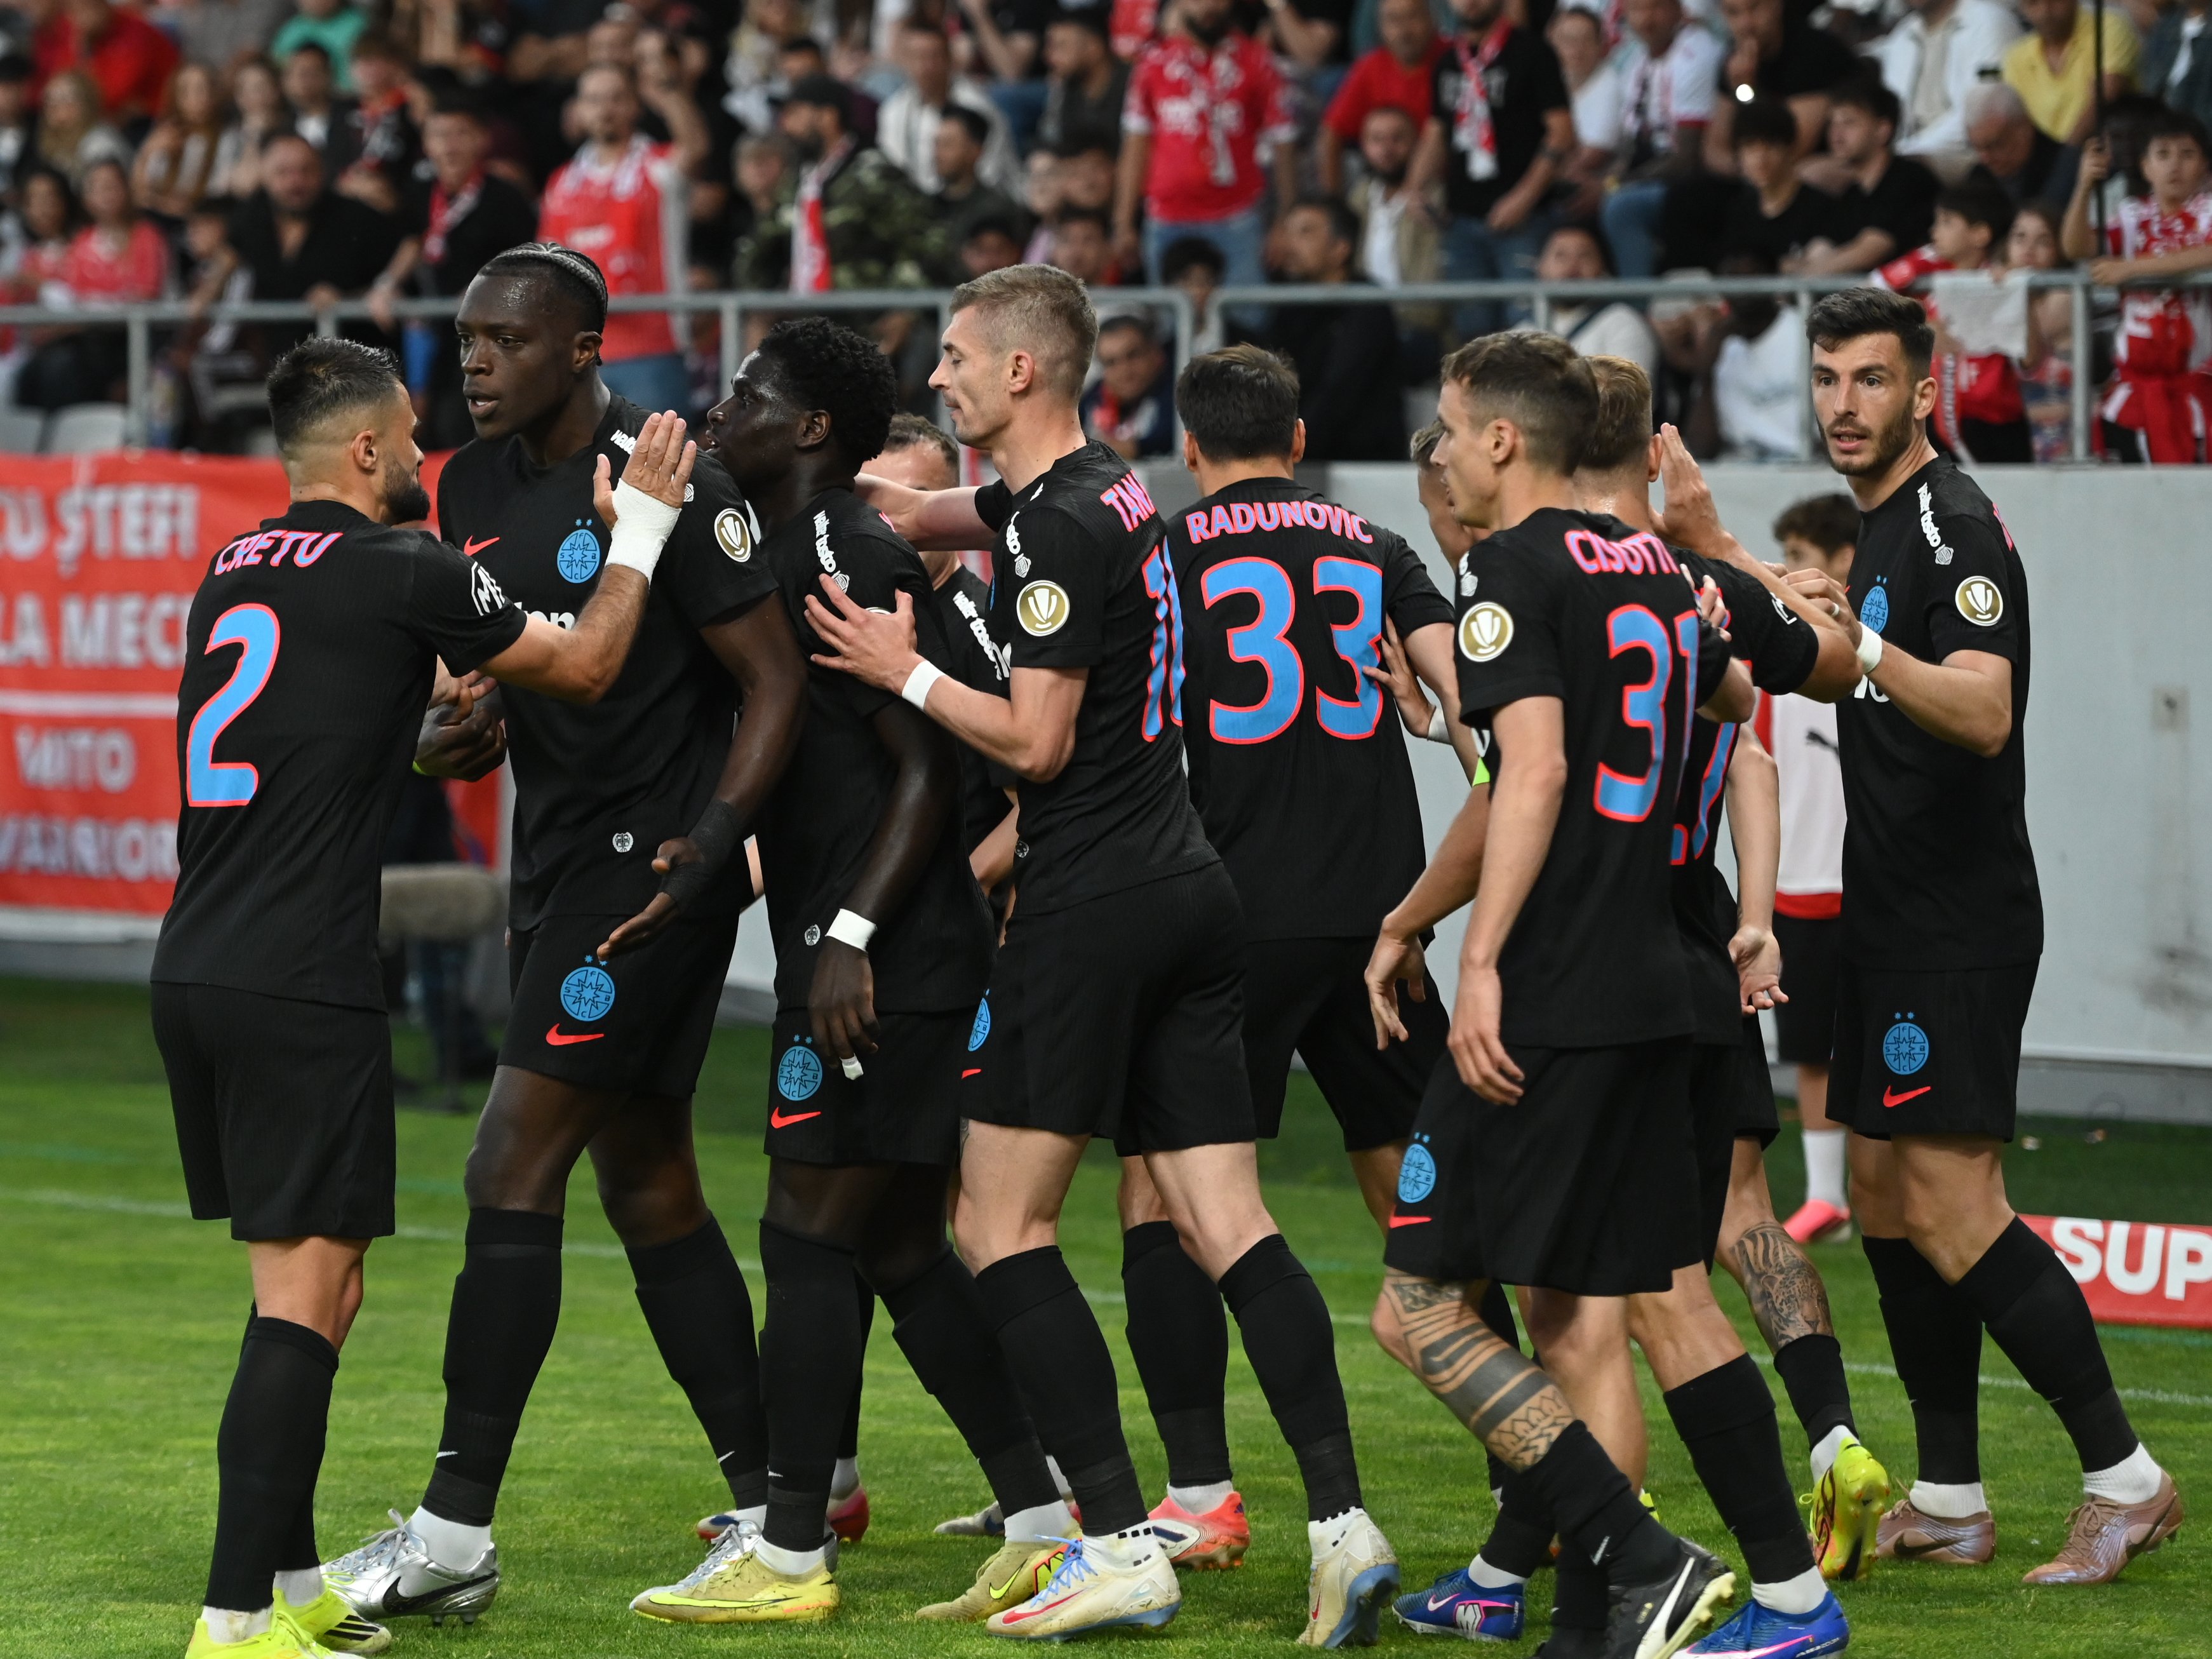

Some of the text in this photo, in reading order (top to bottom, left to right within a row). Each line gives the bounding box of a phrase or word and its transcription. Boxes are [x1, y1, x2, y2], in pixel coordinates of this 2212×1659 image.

[1100, 469, 1156, 532] TAN
[1186, 500, 1373, 544] RADUNOVIC
[215, 530, 344, 575] CRETU
[1201, 556, 1383, 744] 33
[187, 603, 280, 807] 2
[1593, 603, 1700, 823] 31
[2051, 1217, 2212, 1301] SUP
